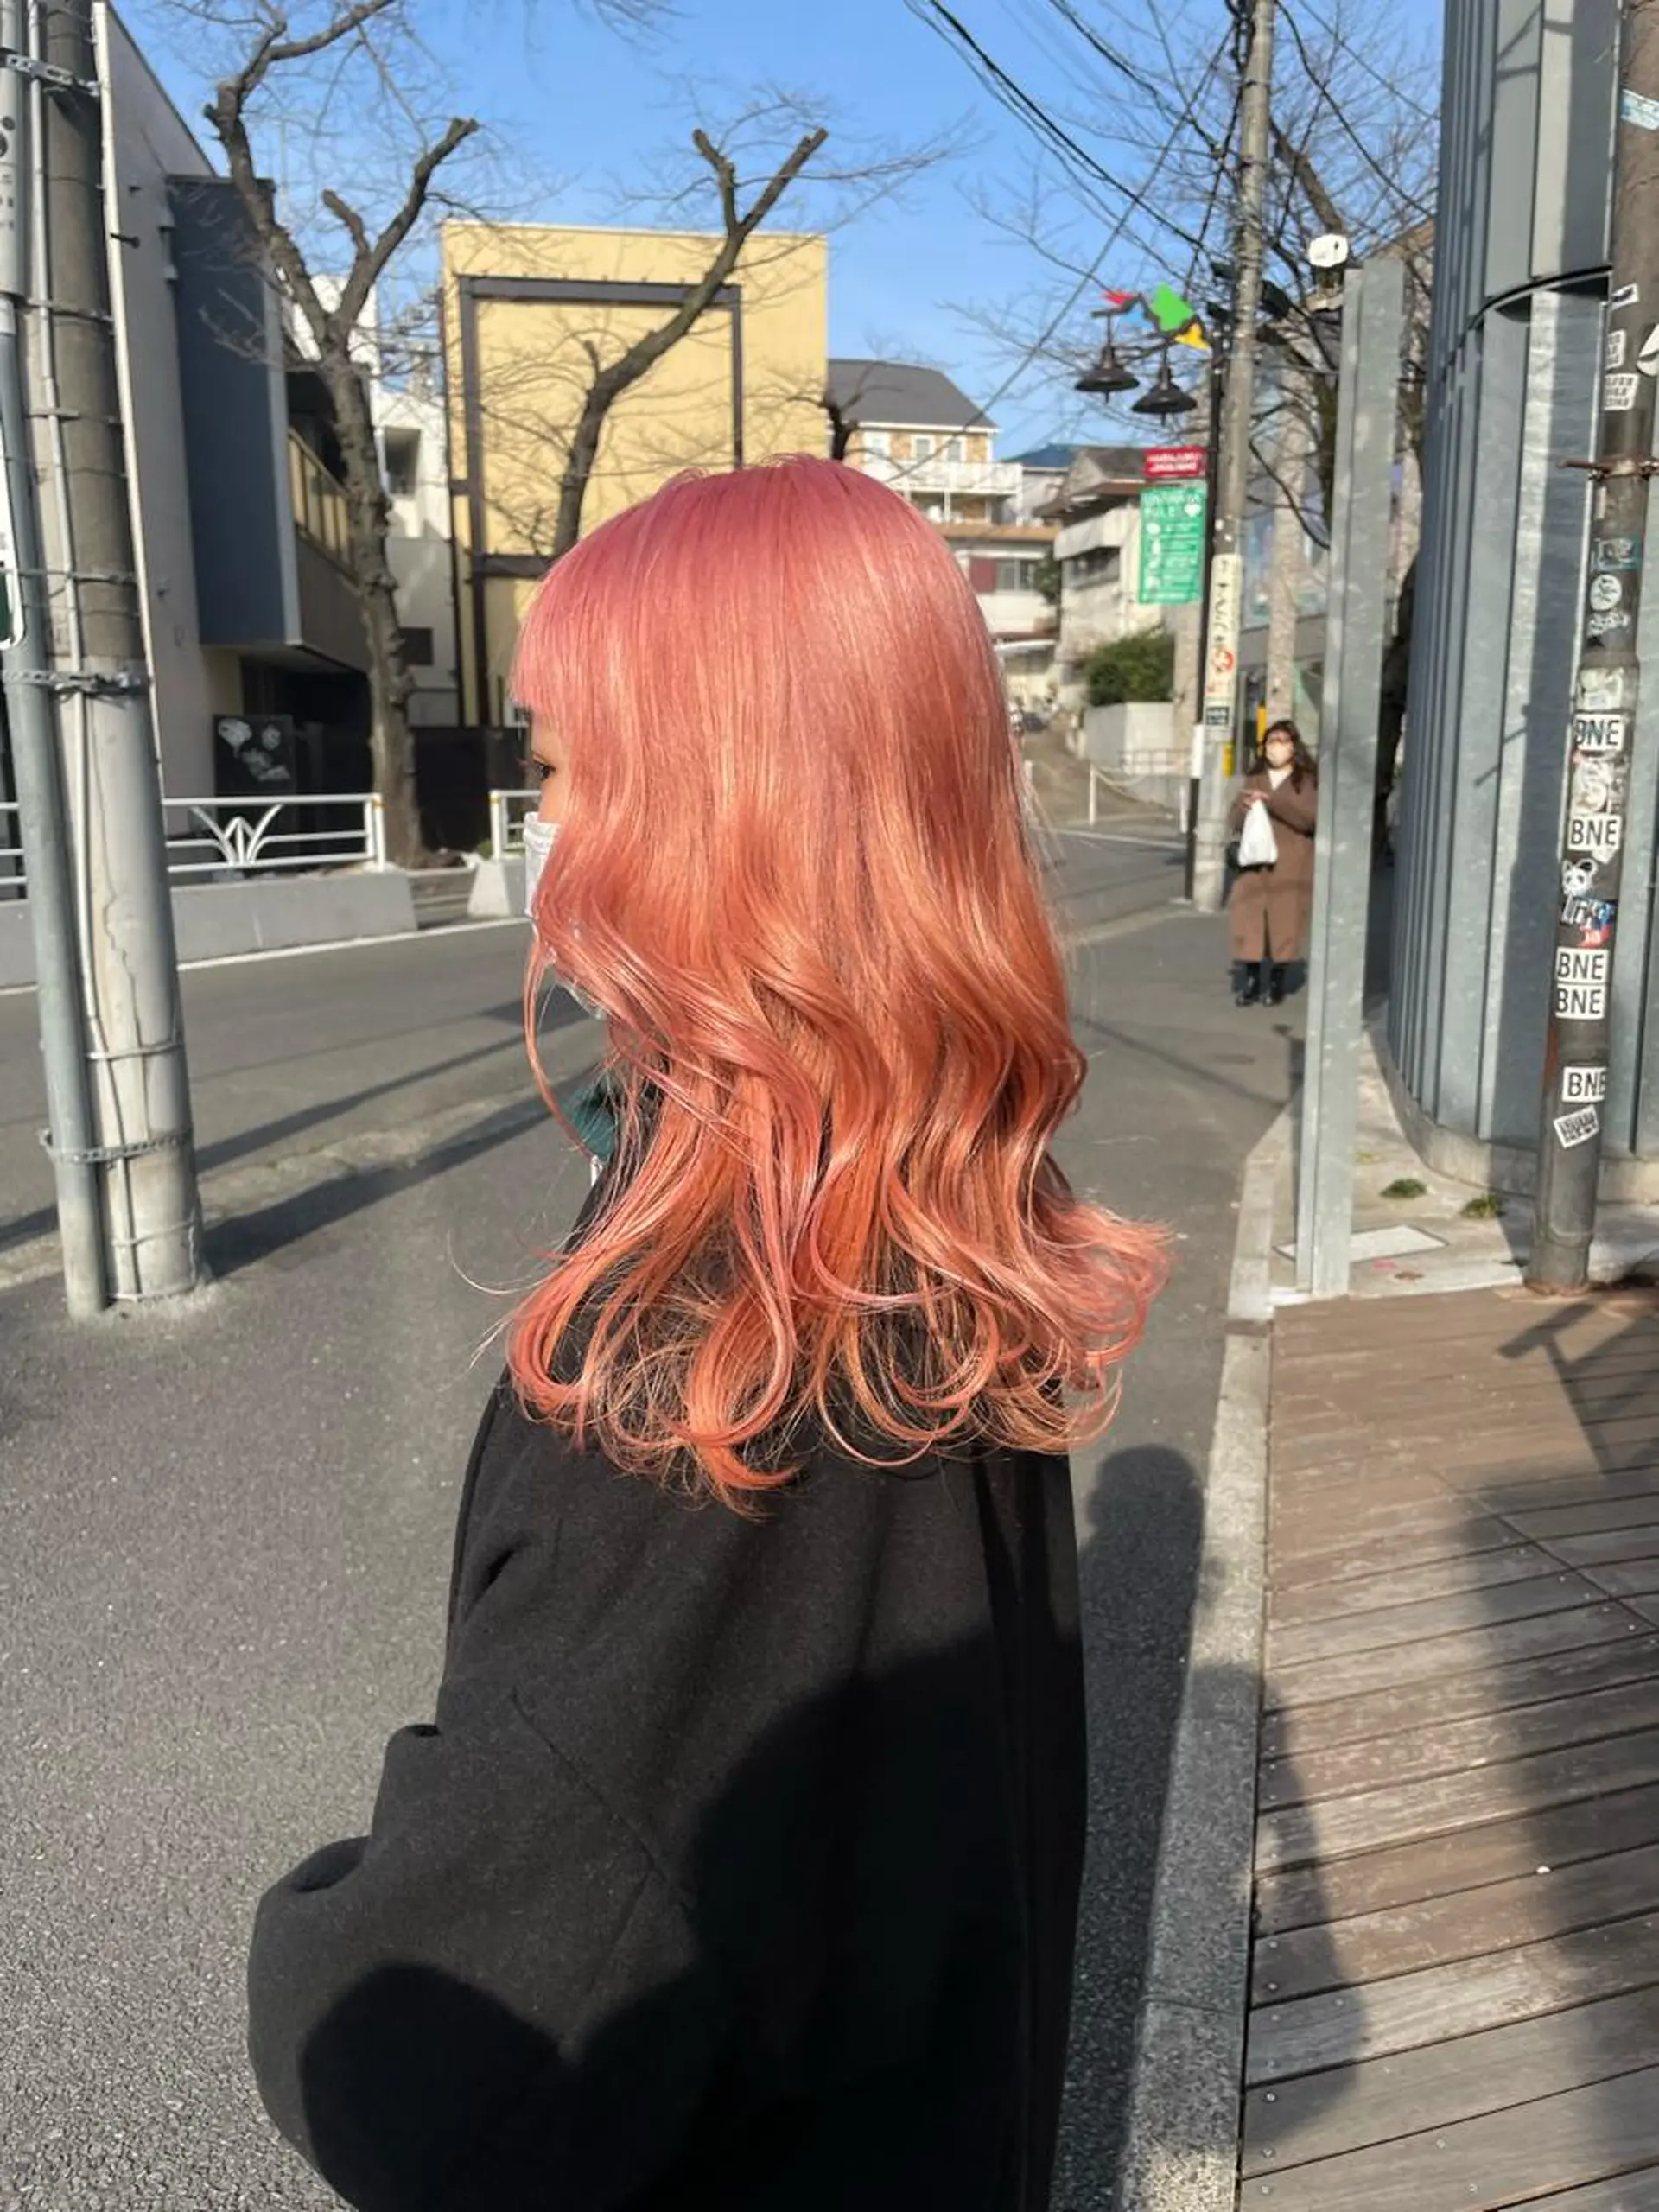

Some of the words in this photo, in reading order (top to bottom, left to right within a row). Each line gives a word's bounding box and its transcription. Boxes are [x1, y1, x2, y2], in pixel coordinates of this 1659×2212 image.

[1575, 719, 1619, 745] BNE
[1571, 819, 1618, 846] BNE
[1558, 953, 1605, 980] BNE
[1556, 988, 1601, 1014] BNE
